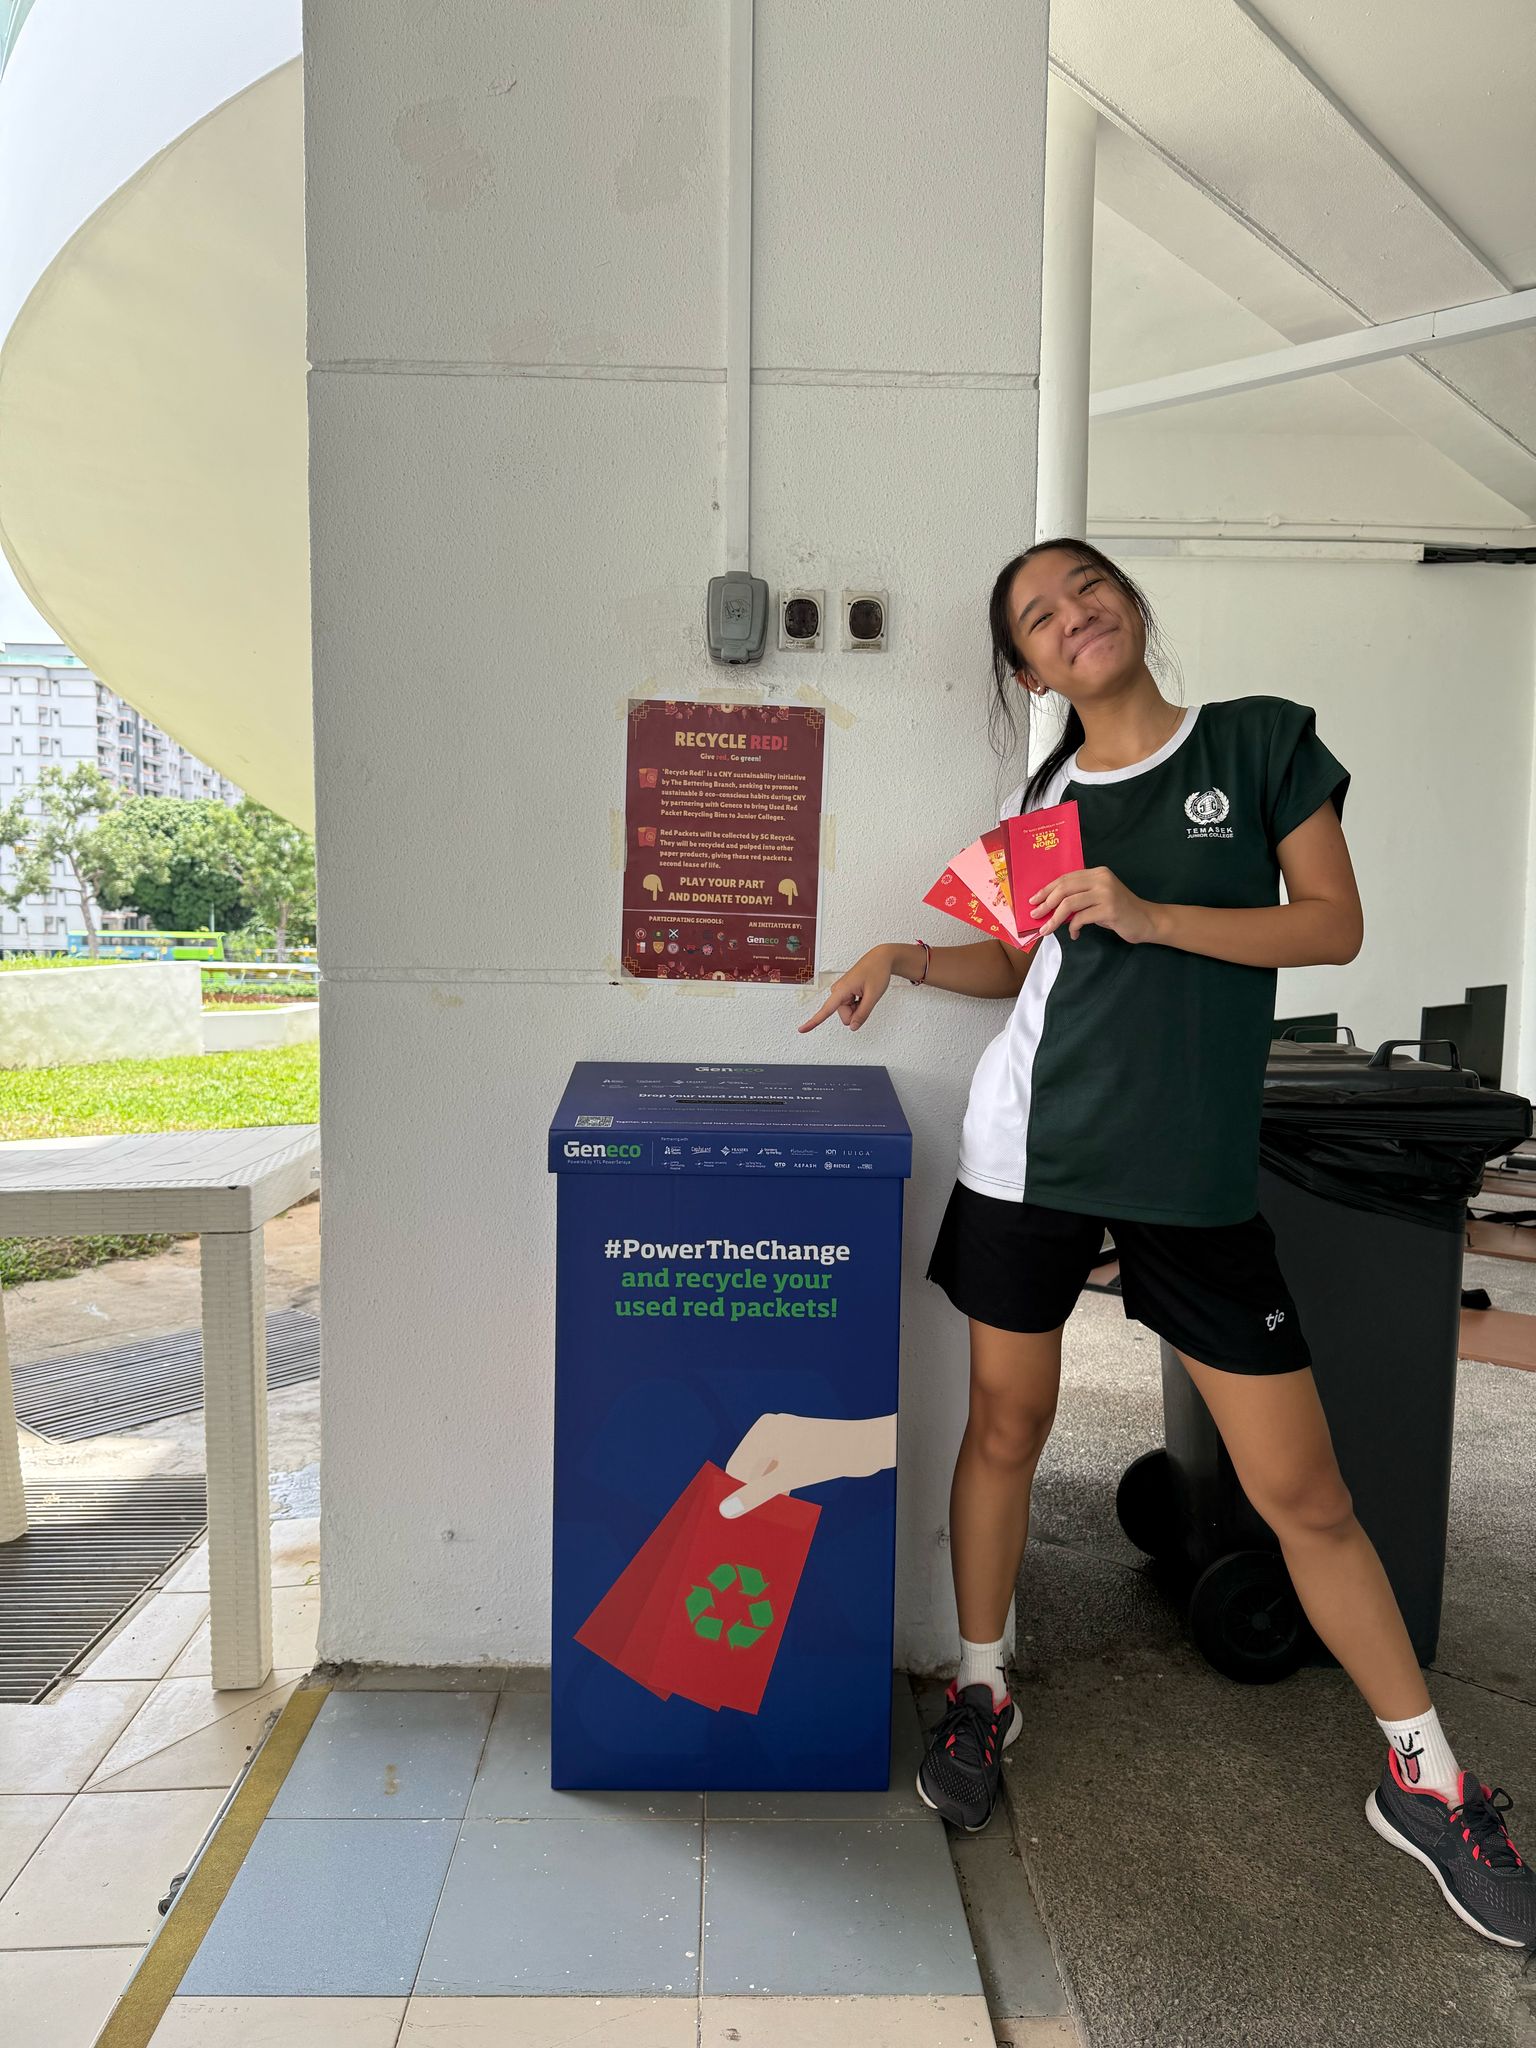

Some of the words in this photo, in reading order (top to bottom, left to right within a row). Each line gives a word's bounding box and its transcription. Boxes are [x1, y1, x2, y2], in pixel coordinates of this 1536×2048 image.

[675, 731, 746, 749] RECYCLE
[750, 735, 788, 750] RED!
[733, 772, 776, 780] sustainability
[683, 780, 712, 788] Bettering
[1033, 838, 1060, 849] UNION
[1036, 833, 1056, 842] GAS
[711, 852, 731, 860] giving
[680, 876, 707, 887] PLAY
[708, 878, 737, 888] YOUR
[738, 879, 765, 889] PART
[668, 892, 690, 902] AND
[692, 893, 735, 904] DONATE
[735, 895, 773, 906] TODAY!
[746, 936, 779, 944] Geneco
[564, 1141, 641, 1157] Geneco
[604, 1239, 850, 1266] #PowerTheChange
[622, 1268, 670, 1288] and
[675, 1268, 767, 1293] recycle
[773, 1273, 832, 1293] your
[615, 1296, 676, 1317] used
[683, 1297, 724, 1317] red
[730, 1298, 838, 1322] packets!
[1265, 1309, 1285, 1331] tjc
